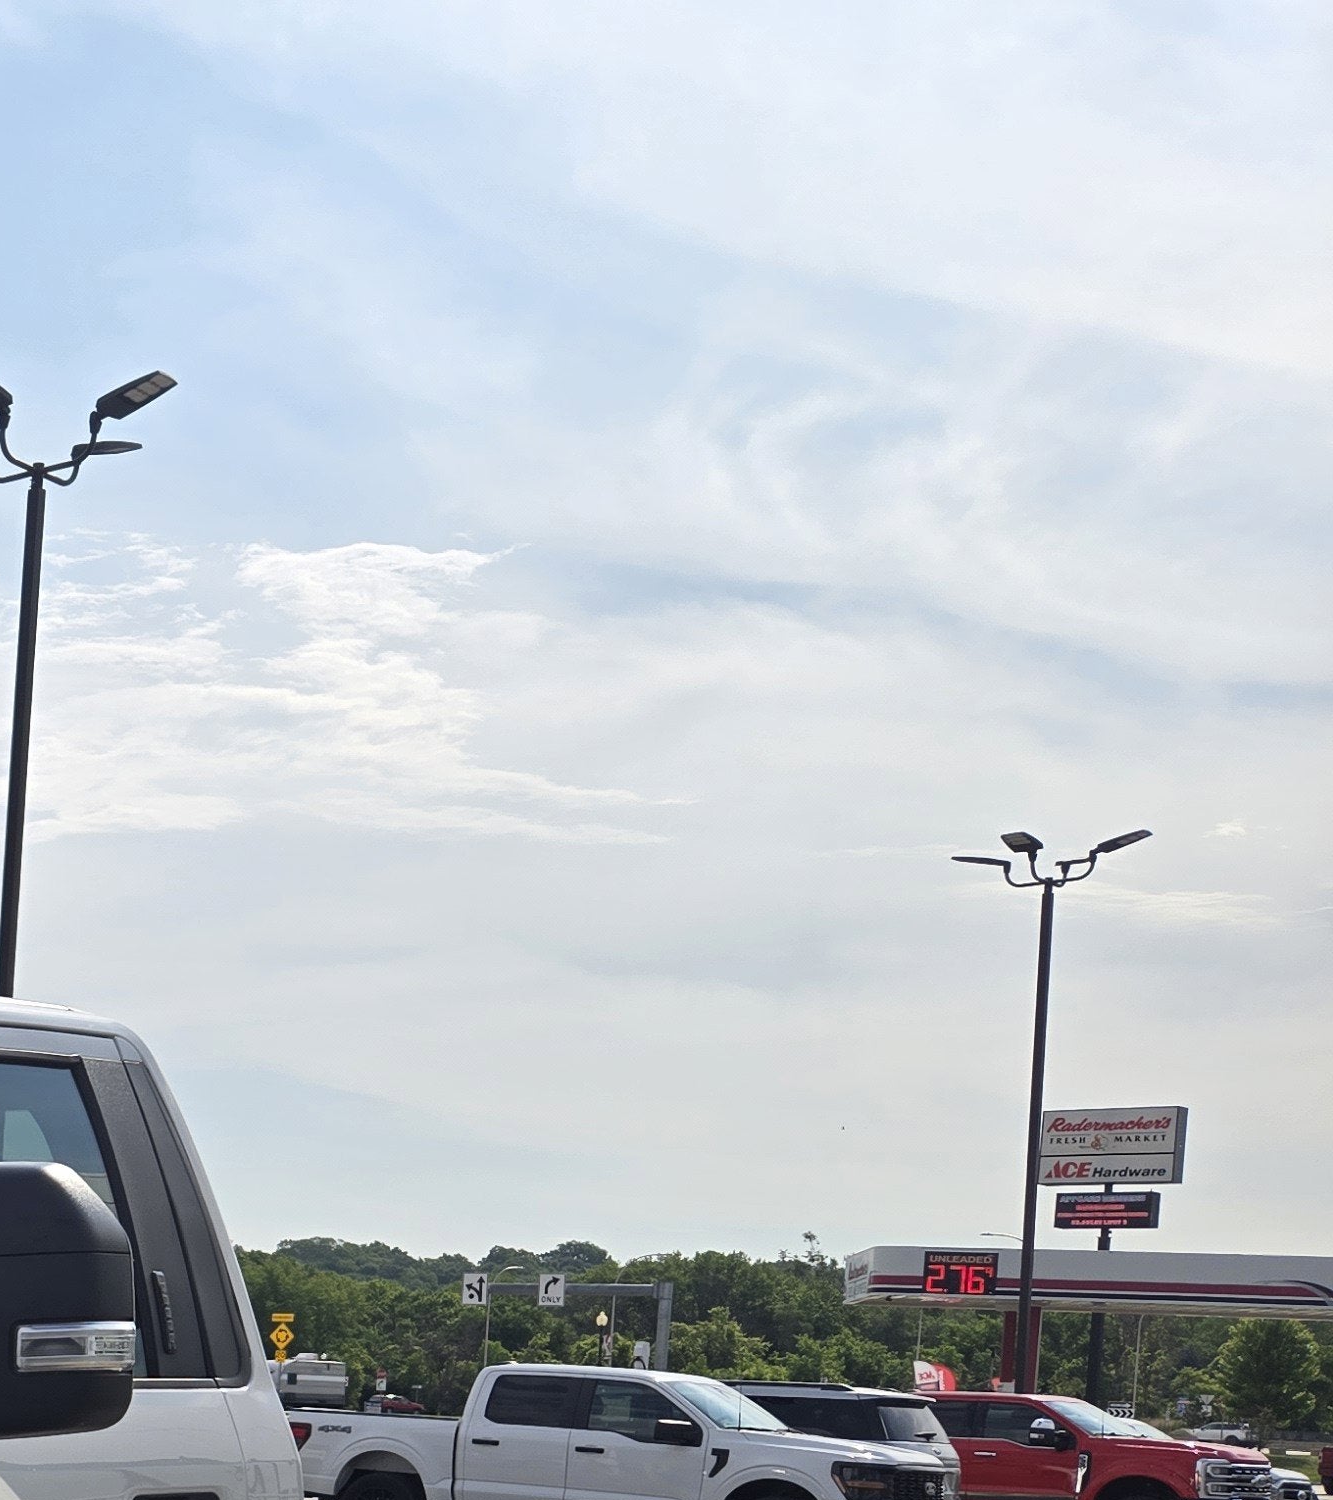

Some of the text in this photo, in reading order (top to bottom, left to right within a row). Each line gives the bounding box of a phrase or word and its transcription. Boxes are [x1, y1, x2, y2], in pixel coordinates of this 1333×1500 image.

[1047, 1115, 1172, 1133] Radermacher's
[1049, 1134, 1166, 1145] FRESH MARKET
[1044, 1159, 1167, 1179] ACE Hardware
[929, 1254, 993, 1264] UNLEADED
[541, 1295, 561, 1303] ONLY
